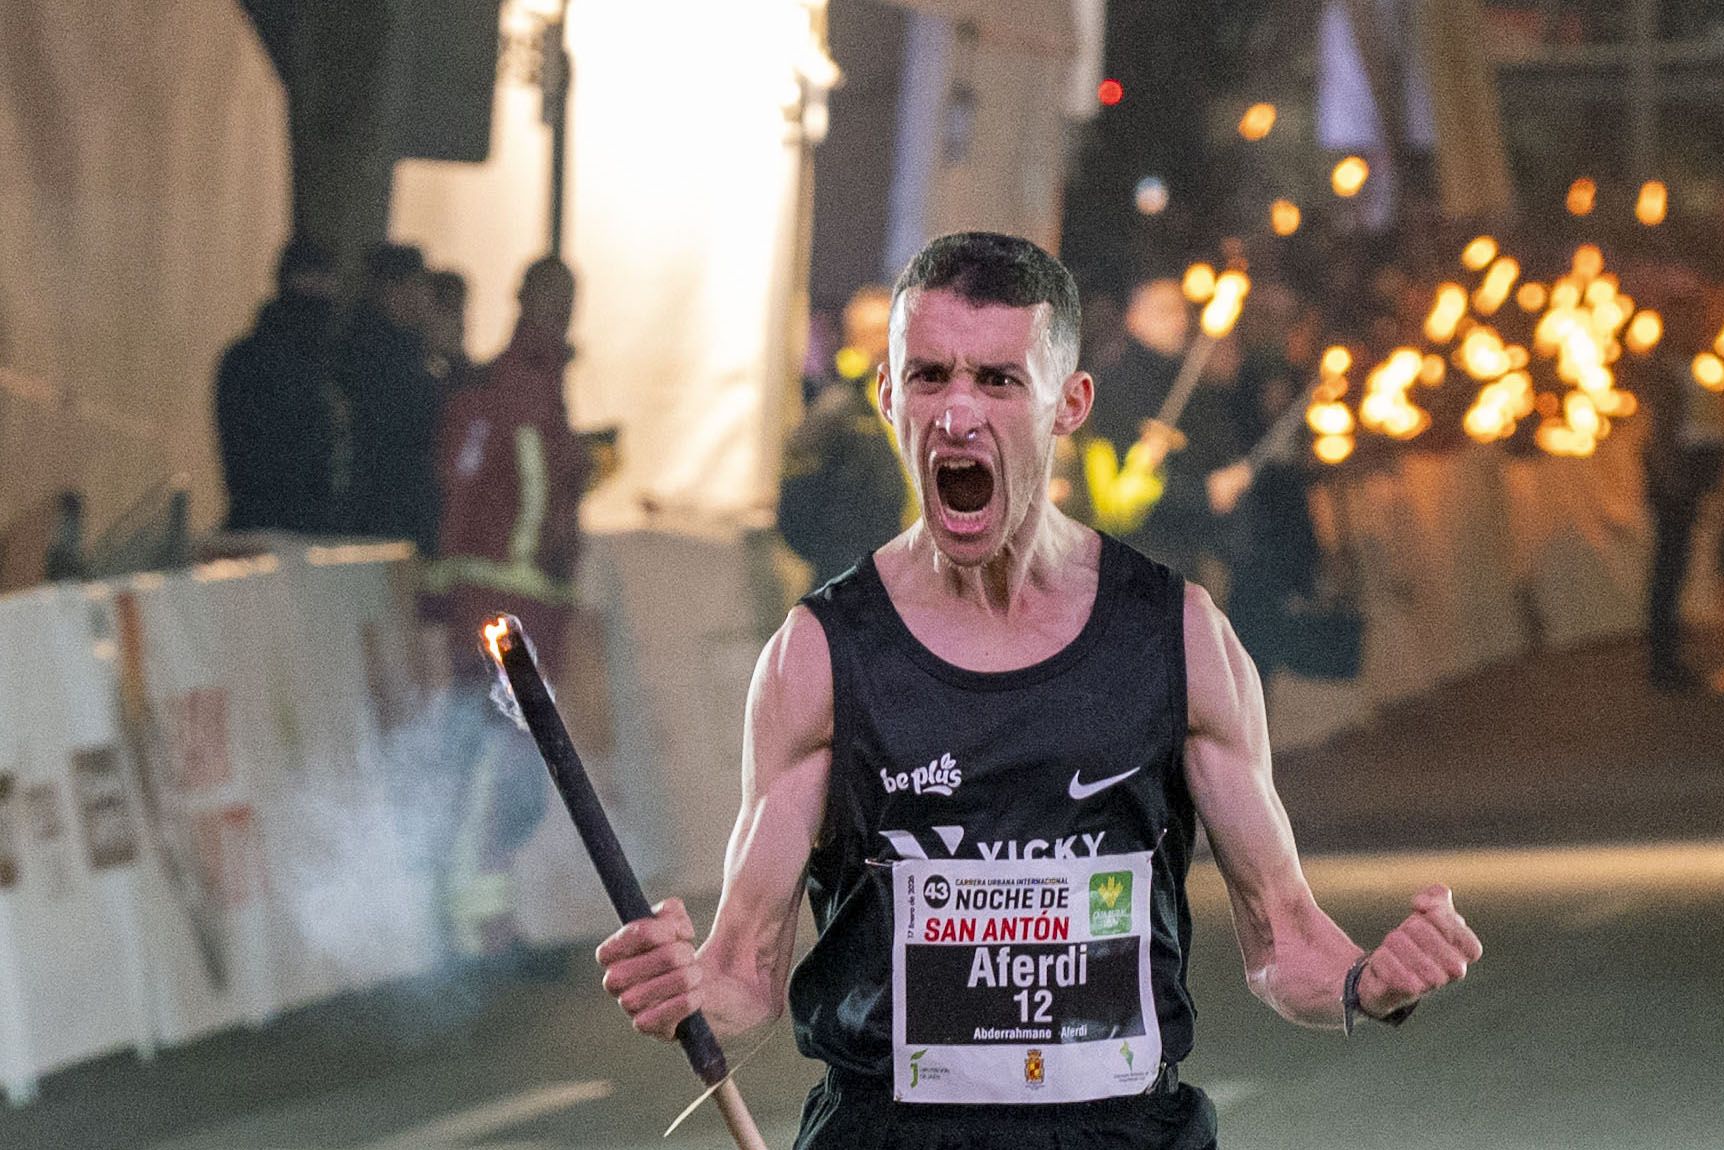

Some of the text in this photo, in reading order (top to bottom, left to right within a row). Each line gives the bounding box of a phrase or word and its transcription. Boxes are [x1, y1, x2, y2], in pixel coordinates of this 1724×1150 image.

[879, 757, 963, 796] be plus
[977, 831, 1107, 861] VICKY
[924, 882, 949, 900] 43
[955, 877, 1068, 886] CARRERA URBANA INTERNACIONAL
[956, 887, 1070, 910] NOCHE DE
[924, 917, 977, 942] SAN
[982, 910, 1070, 941] ANTÓN
[967, 944, 1088, 988] Aferdi
[1013, 989, 1053, 1023] 12
[1060, 1024, 1089, 1038] Aferdi
